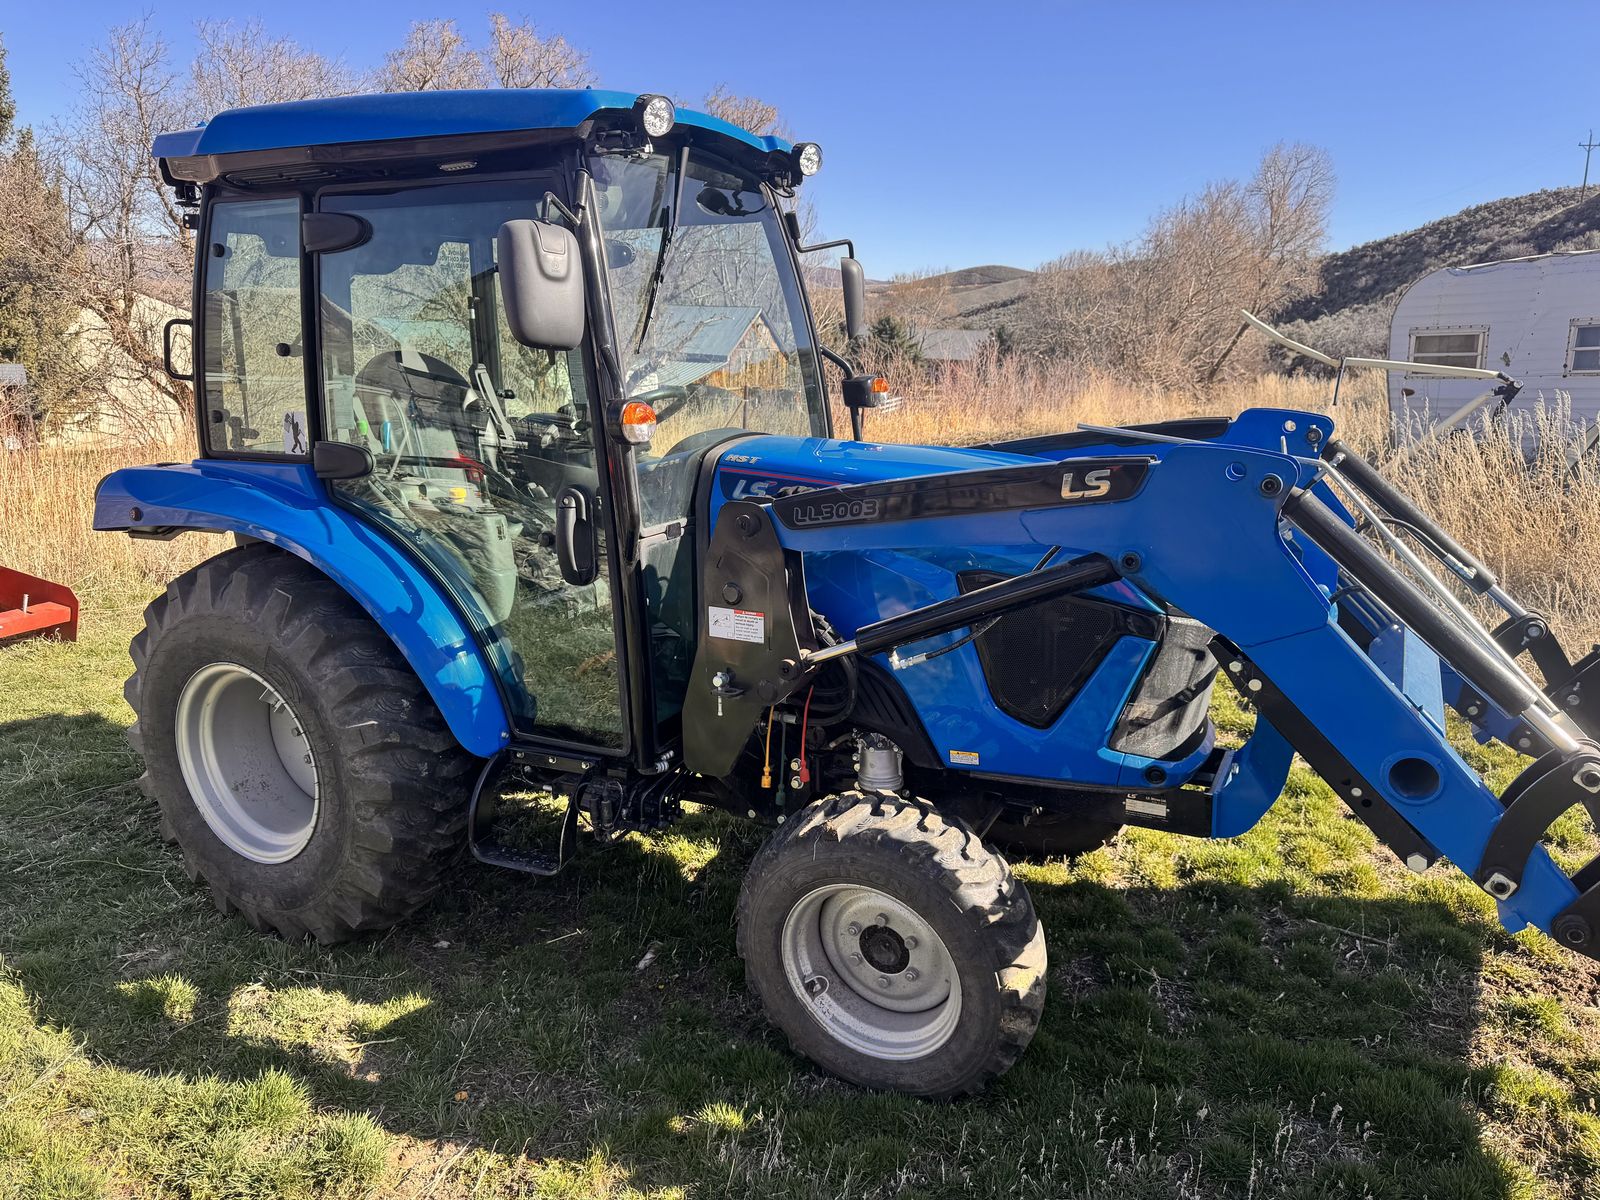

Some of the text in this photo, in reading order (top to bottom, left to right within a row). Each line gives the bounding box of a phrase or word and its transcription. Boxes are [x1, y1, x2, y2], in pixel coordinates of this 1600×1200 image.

[724, 454, 762, 465] HST
[732, 480, 769, 500] LS
[1061, 469, 1111, 499] LS
[793, 500, 880, 525] LL3003
